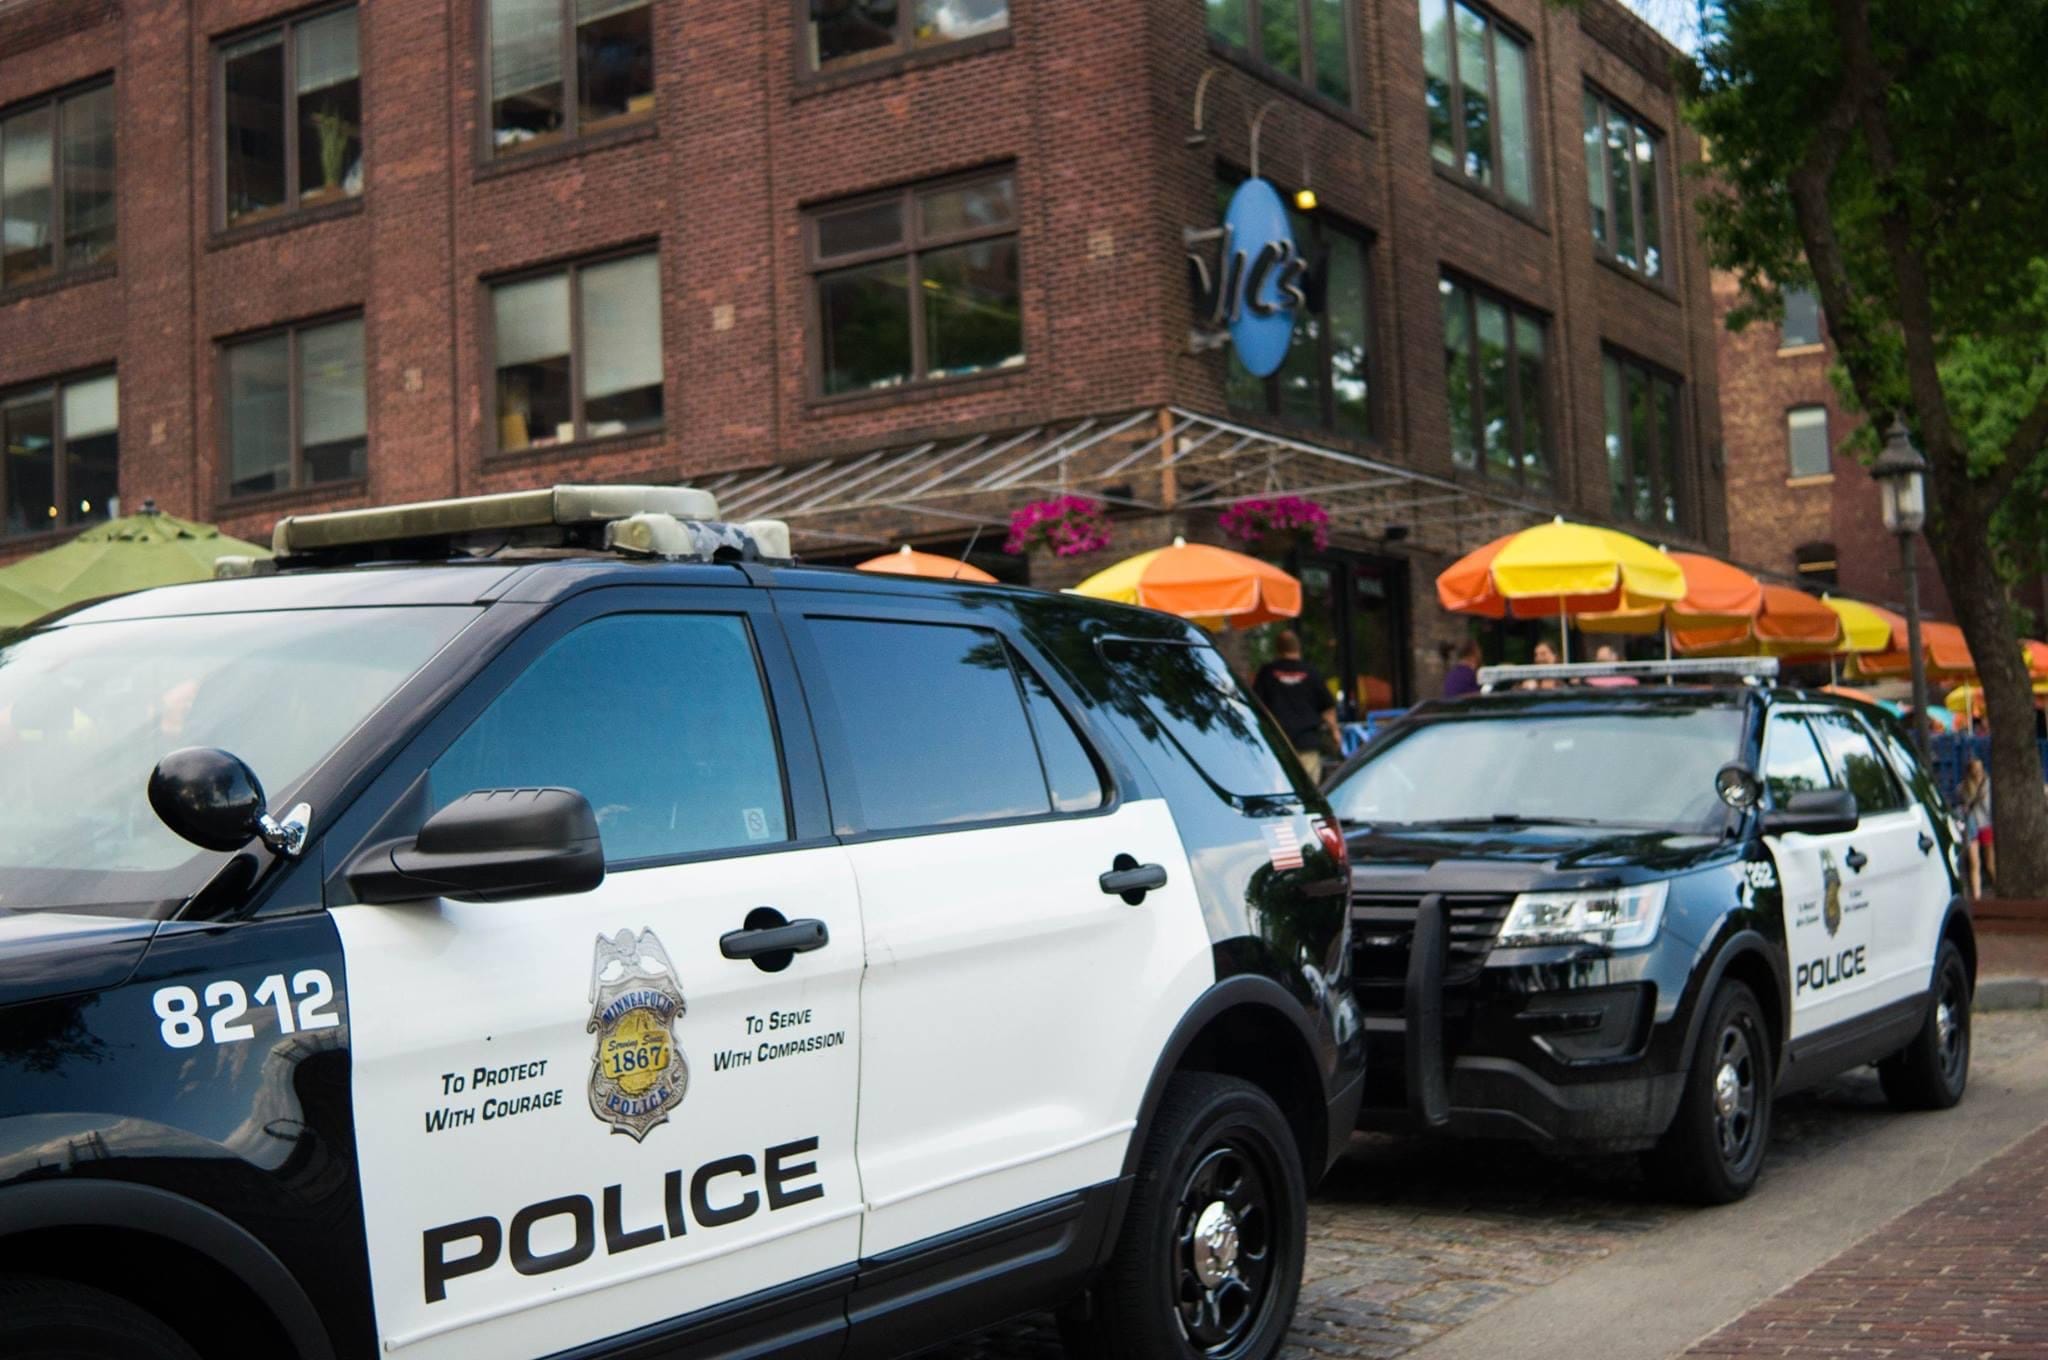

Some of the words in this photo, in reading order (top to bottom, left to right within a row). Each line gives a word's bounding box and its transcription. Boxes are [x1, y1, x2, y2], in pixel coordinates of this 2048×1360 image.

[1796, 945, 1866, 996] POLICE
[153, 969, 339, 1049] 8212
[602, 991, 674, 1025] MINNEAPOLIS
[613, 1046, 662, 1073] 1867
[608, 1086, 670, 1115] POLICE
[423, 1136, 825, 1304] POLICE
